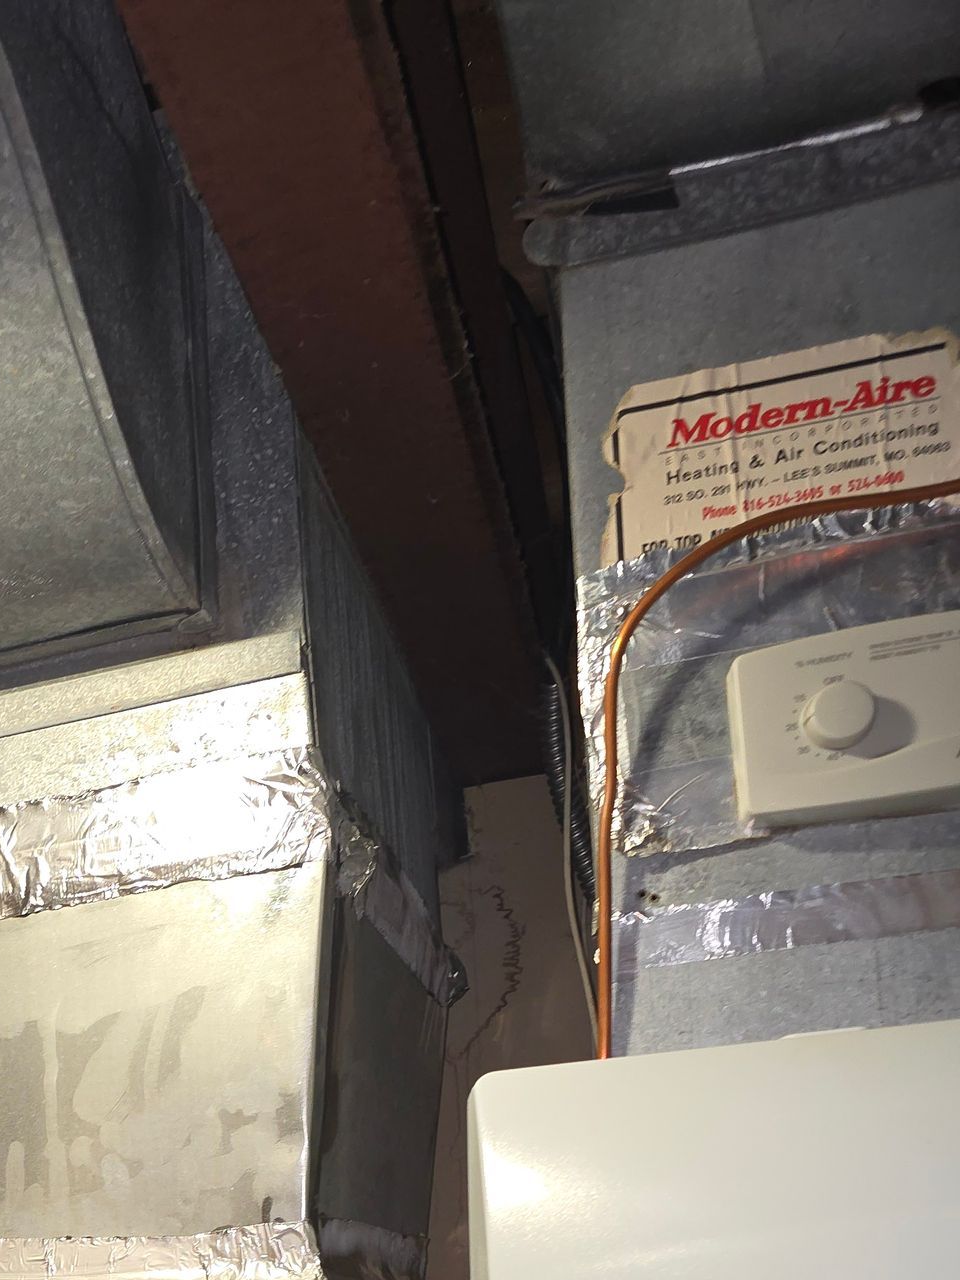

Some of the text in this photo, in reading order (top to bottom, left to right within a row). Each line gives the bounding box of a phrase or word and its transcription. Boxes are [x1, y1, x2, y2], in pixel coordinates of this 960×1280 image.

[666, 375, 937, 448] Modern-Aire
[666, 422, 939, 486] Heating & Air Conditioning
[701, 504, 738, 520] Phone
